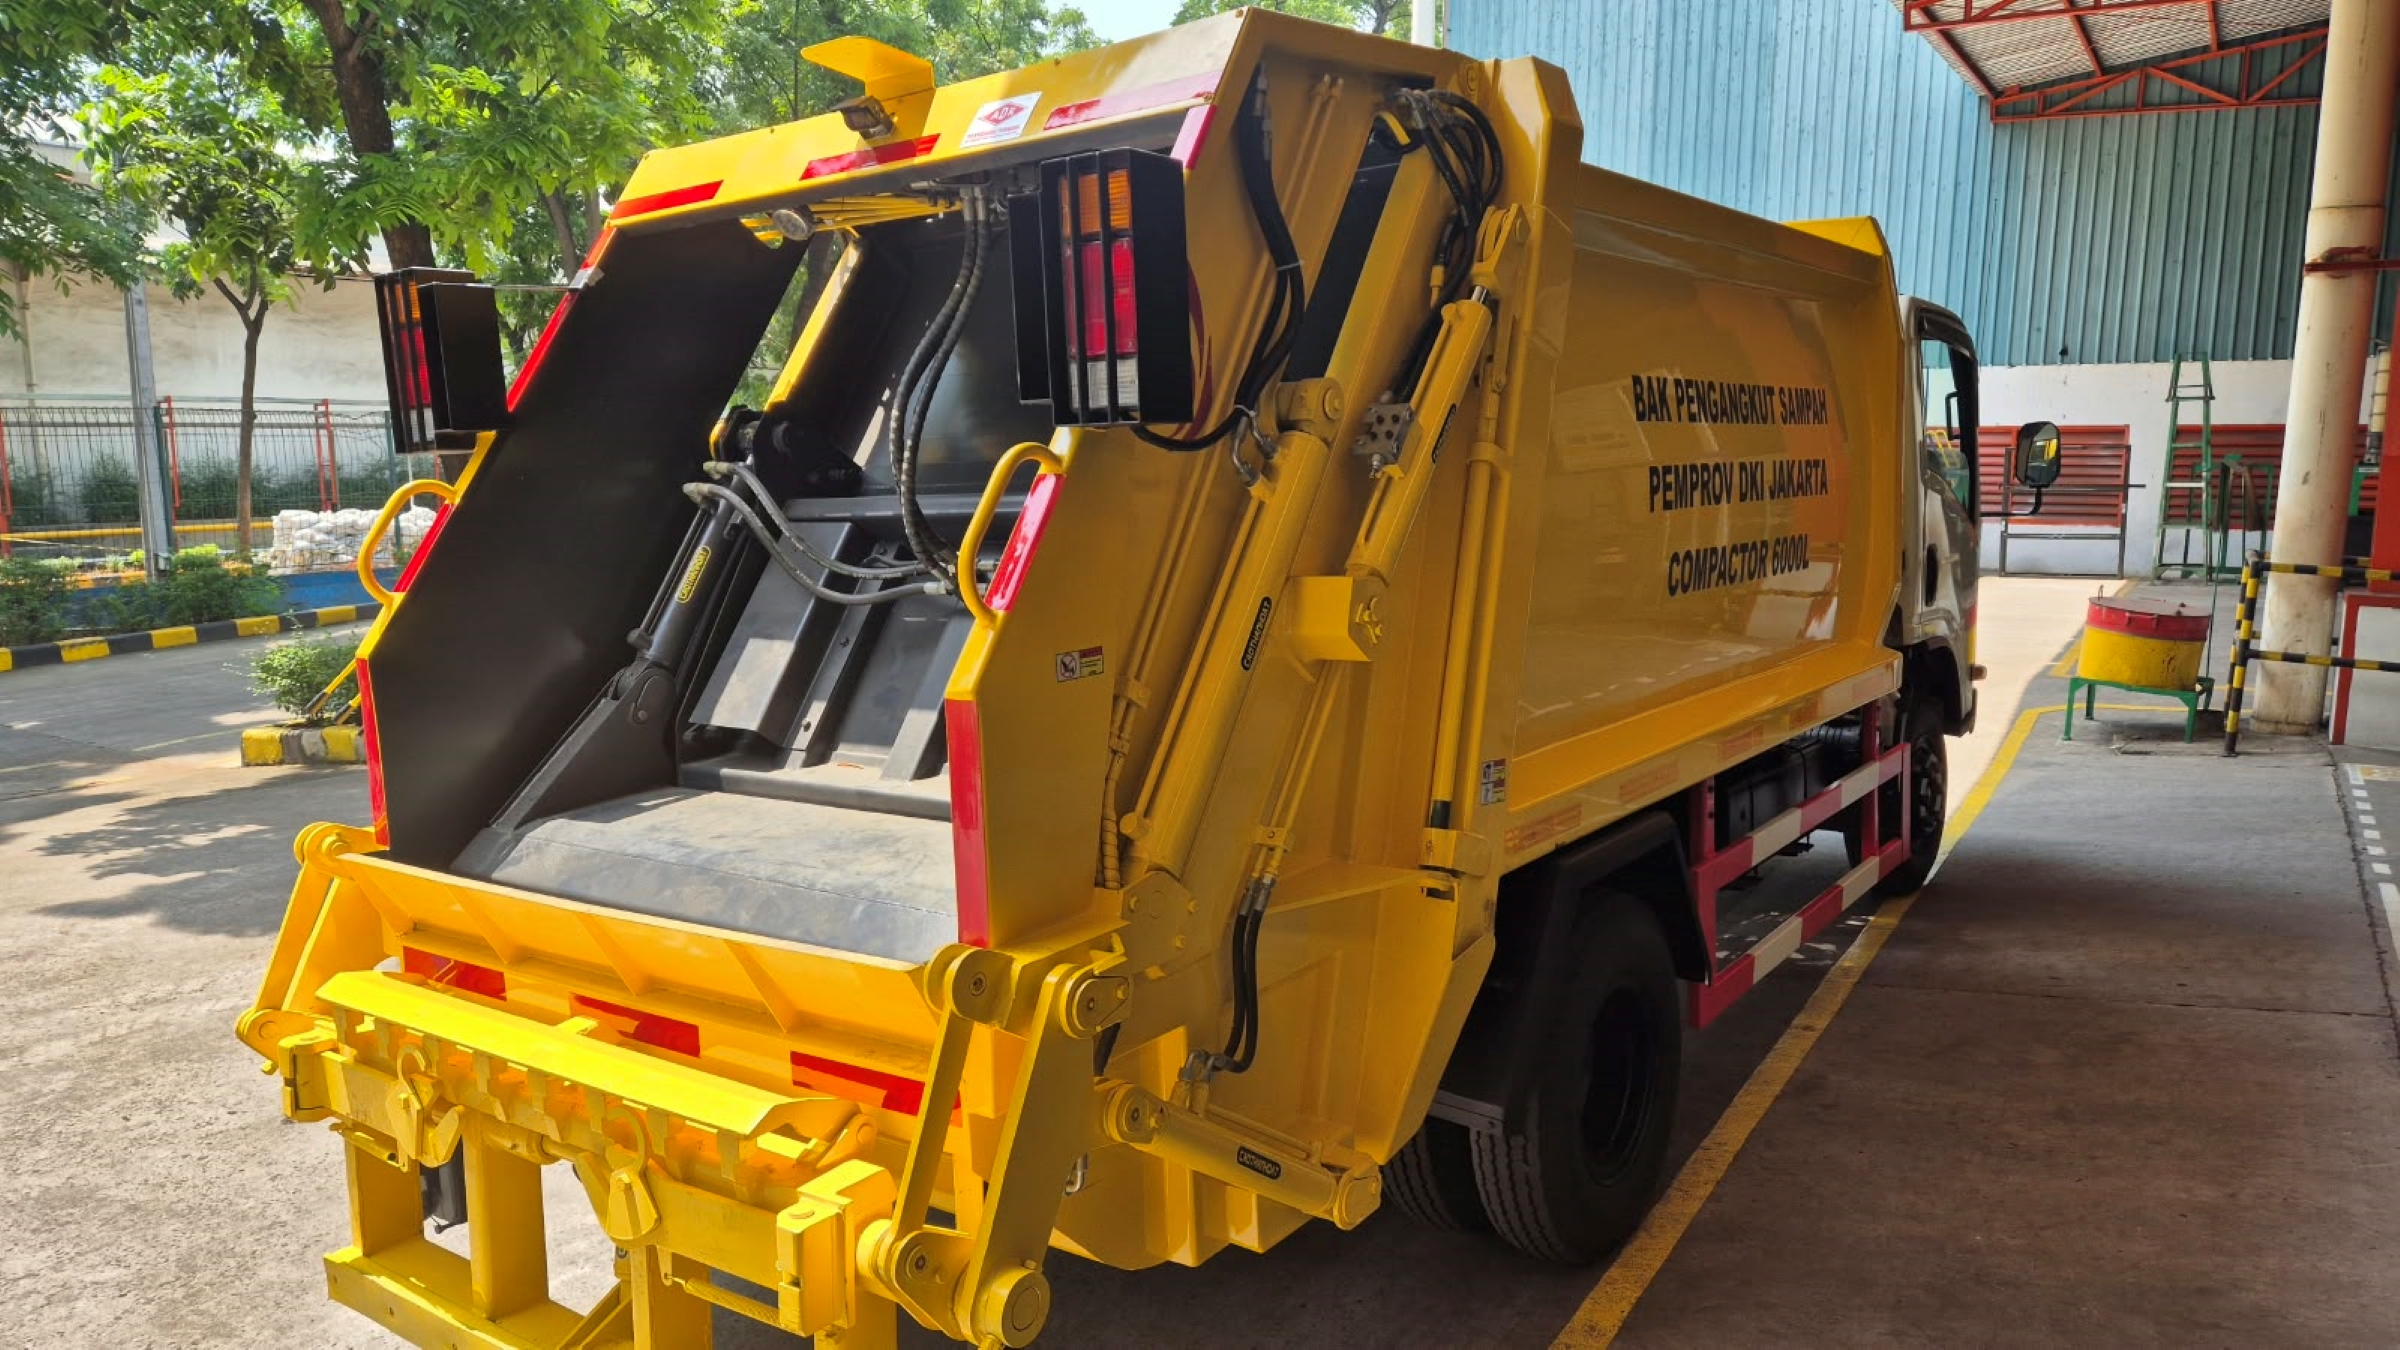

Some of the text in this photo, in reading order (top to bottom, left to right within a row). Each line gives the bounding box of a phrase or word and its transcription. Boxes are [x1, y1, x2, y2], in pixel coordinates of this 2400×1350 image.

[1631, 374, 1828, 425] BAK PENGANGKUT SAMPAH
[1649, 459, 1828, 513] PEMPROV DKI JAKARTA
[1667, 533, 1809, 597] COMPACTOR 6000L
